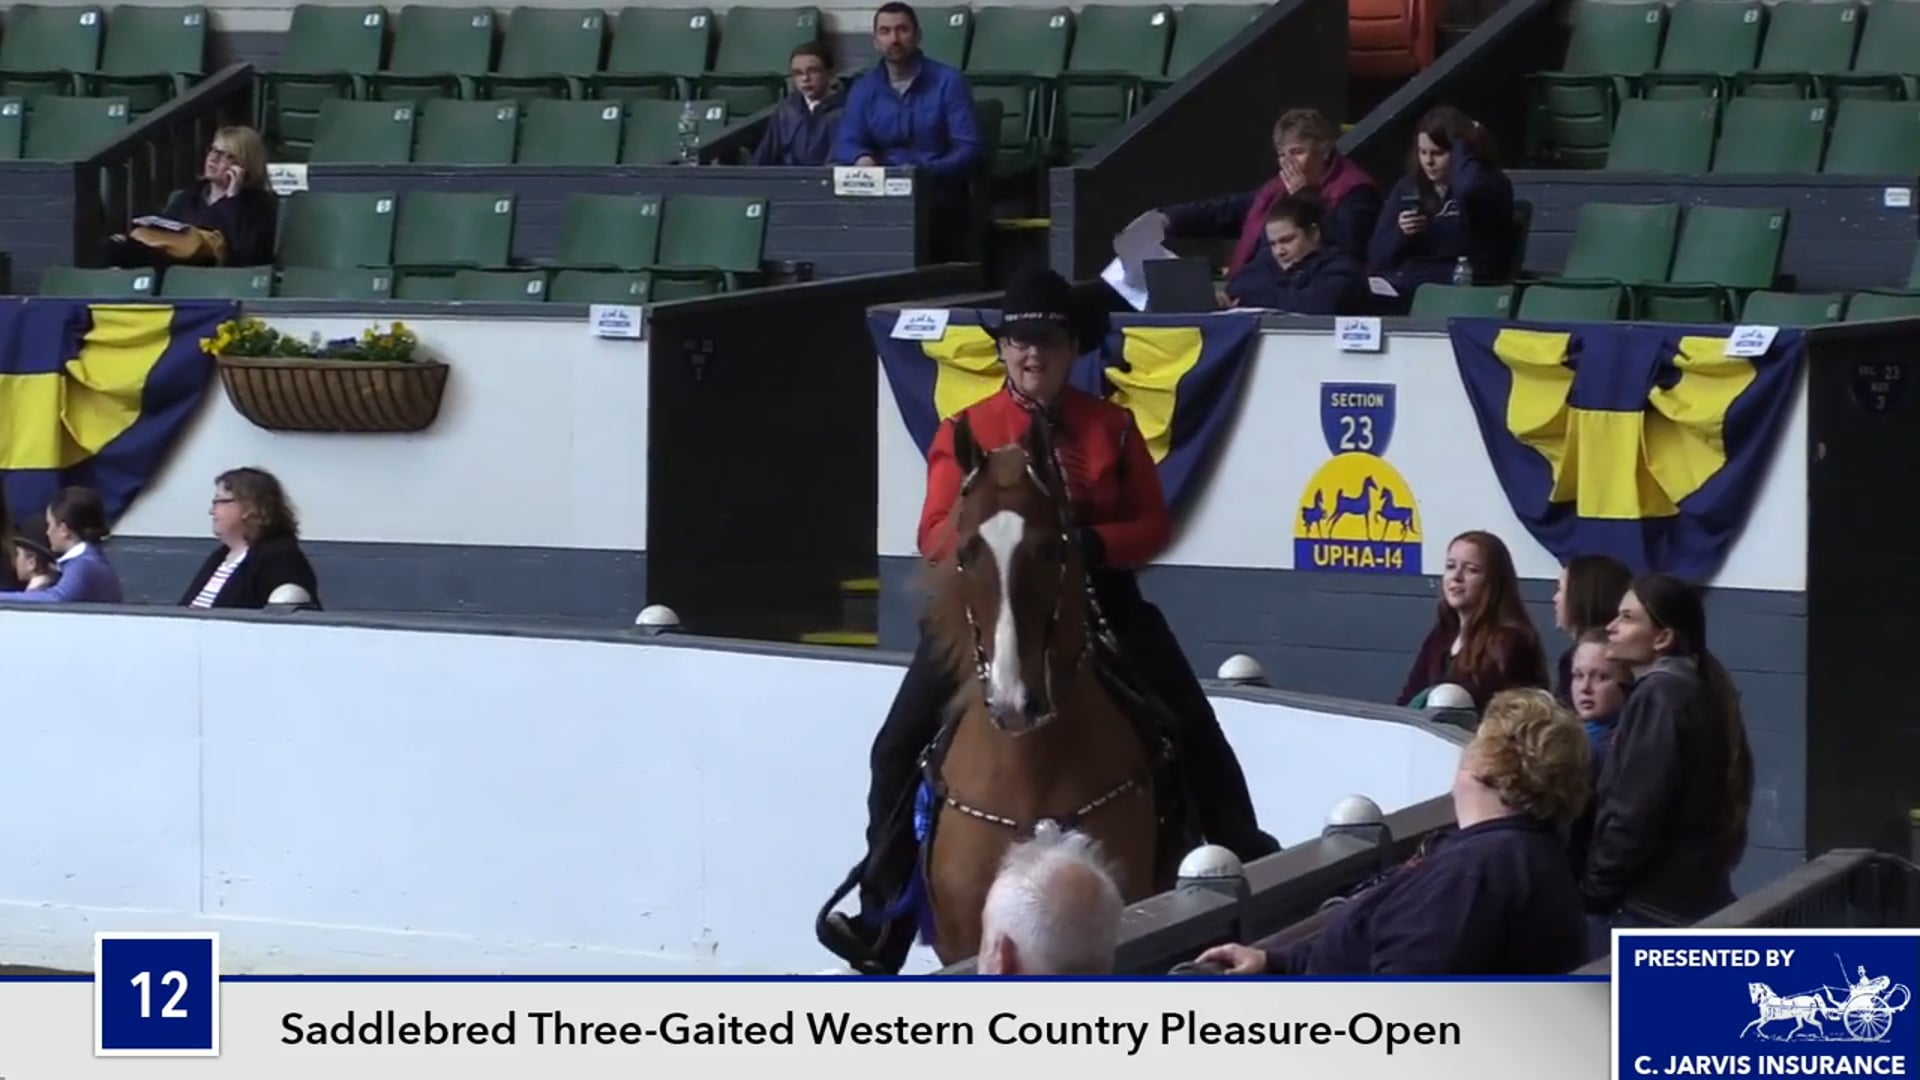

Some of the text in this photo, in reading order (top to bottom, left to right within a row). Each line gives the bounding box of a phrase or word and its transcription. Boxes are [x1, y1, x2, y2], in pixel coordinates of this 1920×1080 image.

[1884, 364, 1901, 381] 23
[1331, 392, 1384, 408] SECTION
[1339, 415, 1374, 450] 23
[1313, 545, 1404, 569] UPHA-14
